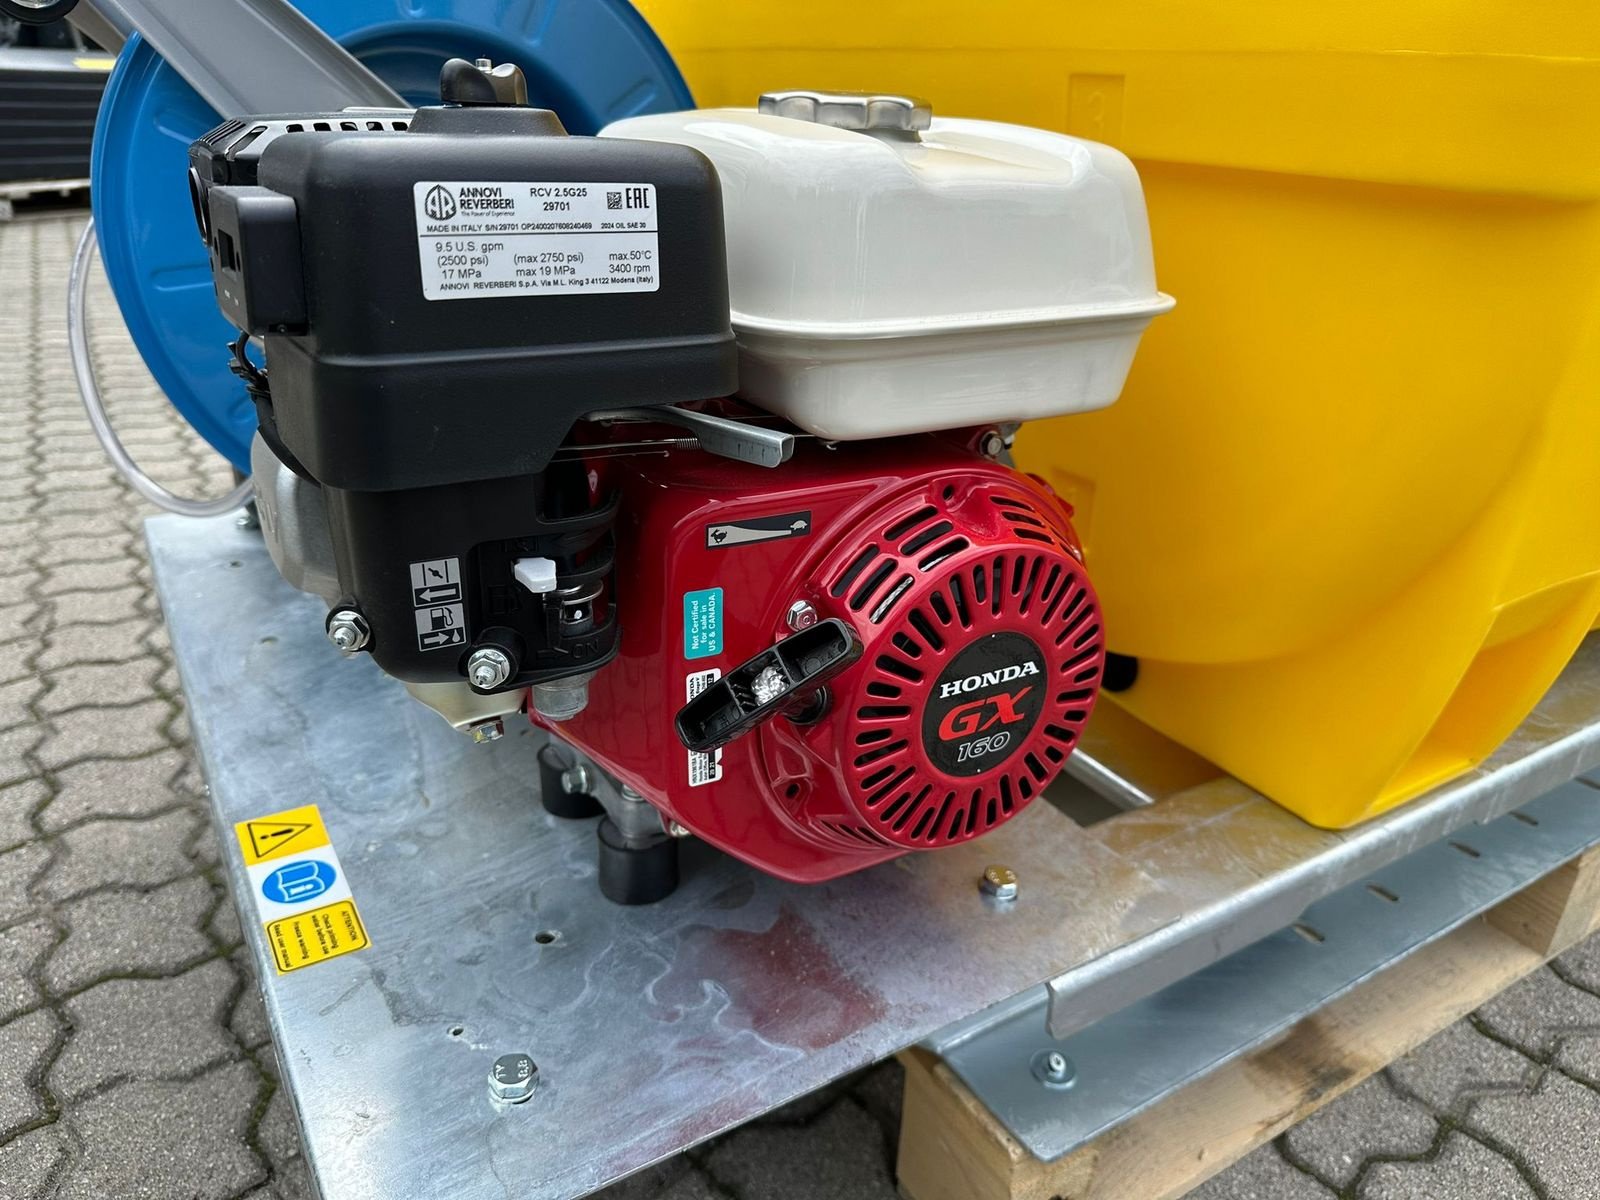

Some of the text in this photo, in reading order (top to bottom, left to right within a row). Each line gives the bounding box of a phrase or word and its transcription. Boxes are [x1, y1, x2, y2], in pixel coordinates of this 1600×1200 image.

[459, 187, 502, 198] ANNOVI
[530, 188, 588, 197] RCV 2.5G25
[460, 198, 514, 209] REVERBERI
[543, 201, 571, 211] 29701
[426, 224, 449, 232] MADE
[451, 224, 460, 232] IN
[460, 224, 482, 232] ITALY
[435, 241, 504, 254] 9.5 U.S. gpm
[437, 254, 489, 268] (2500 psi)
[513, 252, 584, 265] (max 2750 psi)
[442, 268, 482, 279] 17 MPa
[516, 265, 576, 276] max 19 MPa
[608, 264, 651, 274] 3400 rpm
[440, 282, 470, 291] ANNOVI
[473, 281, 516, 289] REVERBERI
[518, 280, 538, 288] S.p.A.
[568, 278, 584, 286] King
[610, 276, 635, 284] Modena
[636, 276, 654, 284] (Italy)
[708, 592, 716, 630] CANADA.
[691, 600, 699, 650] Not Certified
[700, 604, 708, 644] for sale in
[708, 640, 716, 652] US
[939, 660, 1040, 699] HONDA
[938, 686, 1034, 742] GX
[957, 730, 1011, 763] 160
[322, 914, 332, 929] Check
[342, 910, 357, 941] ATTENTION
[298, 938, 310, 960] warning
